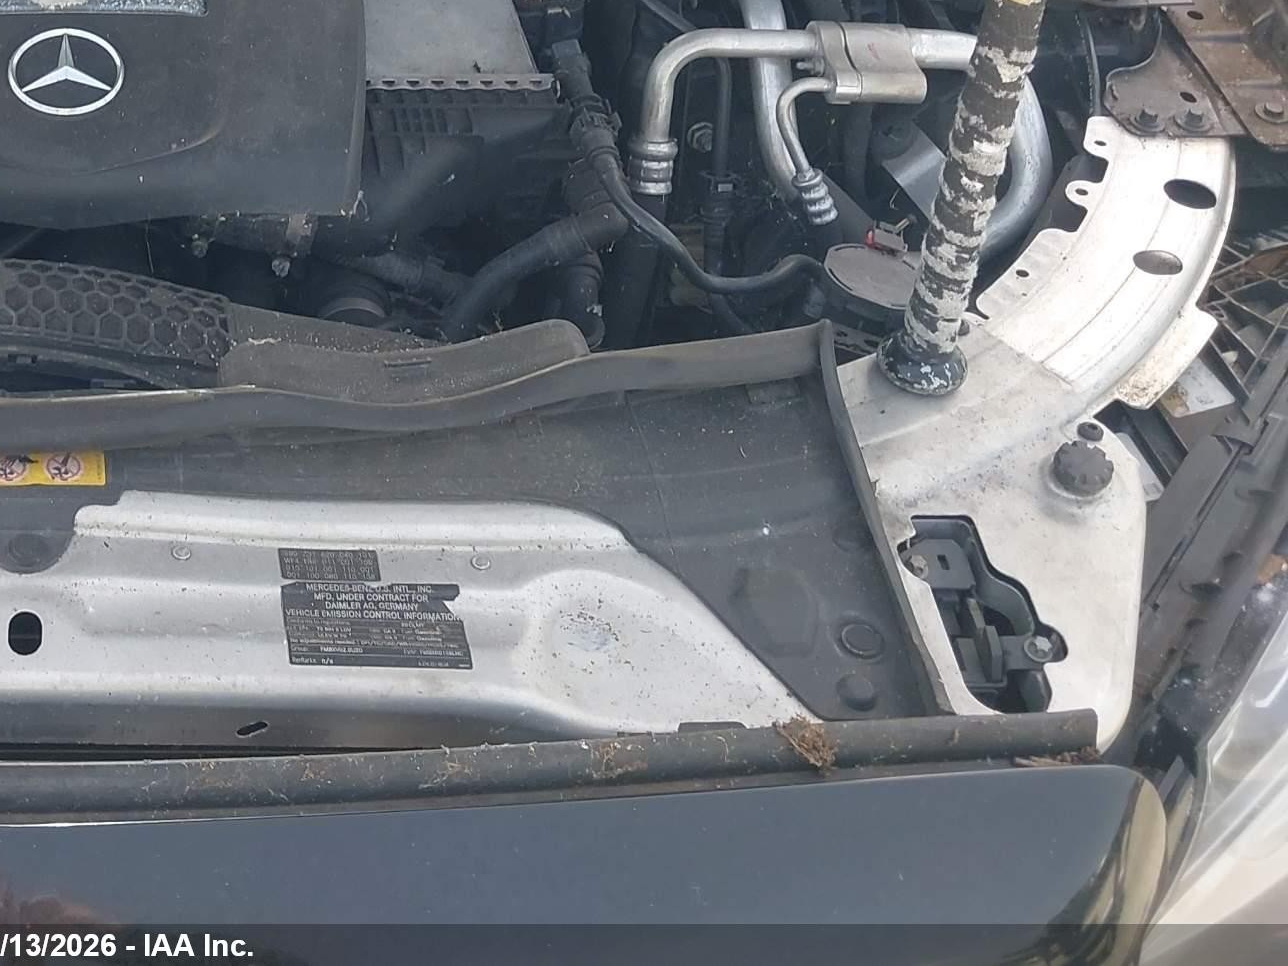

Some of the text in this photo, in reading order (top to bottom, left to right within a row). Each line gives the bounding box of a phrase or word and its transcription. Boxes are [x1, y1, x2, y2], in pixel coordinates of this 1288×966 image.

[336, 593, 365, 601] UNDER
[366, 594, 410, 602] CONTRACT
[412, 594, 429, 602] FOR
[325, 601, 362, 610] DAIMLER
[378, 602, 419, 611] GERMANY
[321, 609, 362, 618] EMISSION
[363, 610, 402, 619] CONTROL
